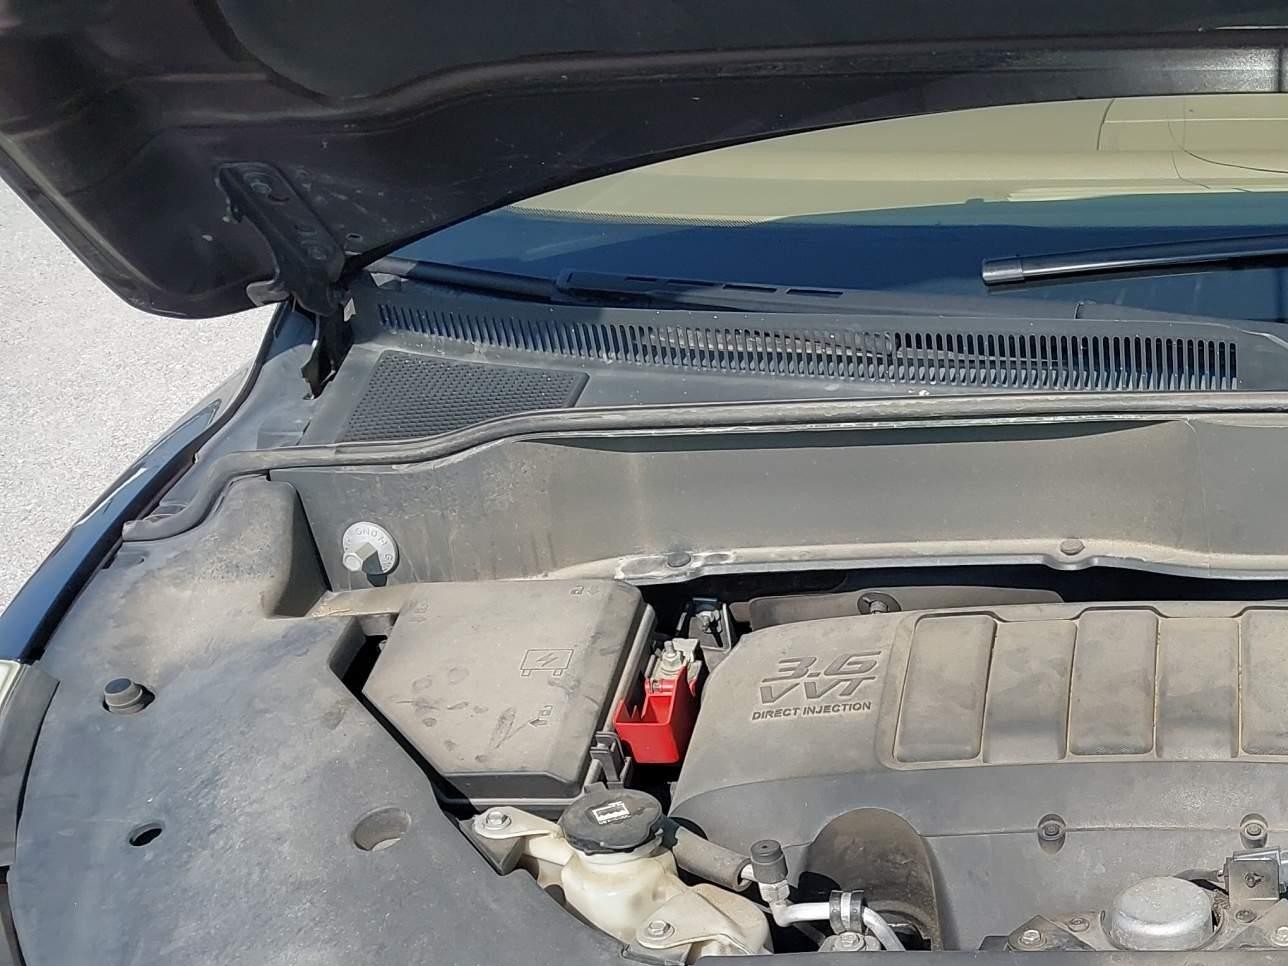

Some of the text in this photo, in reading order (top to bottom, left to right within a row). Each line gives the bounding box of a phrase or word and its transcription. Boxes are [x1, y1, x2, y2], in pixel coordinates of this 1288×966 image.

[761, 650, 882, 683] 3.6
[759, 676, 876, 704] VVT
[751, 701, 872, 721] DIRECT INJECTION
